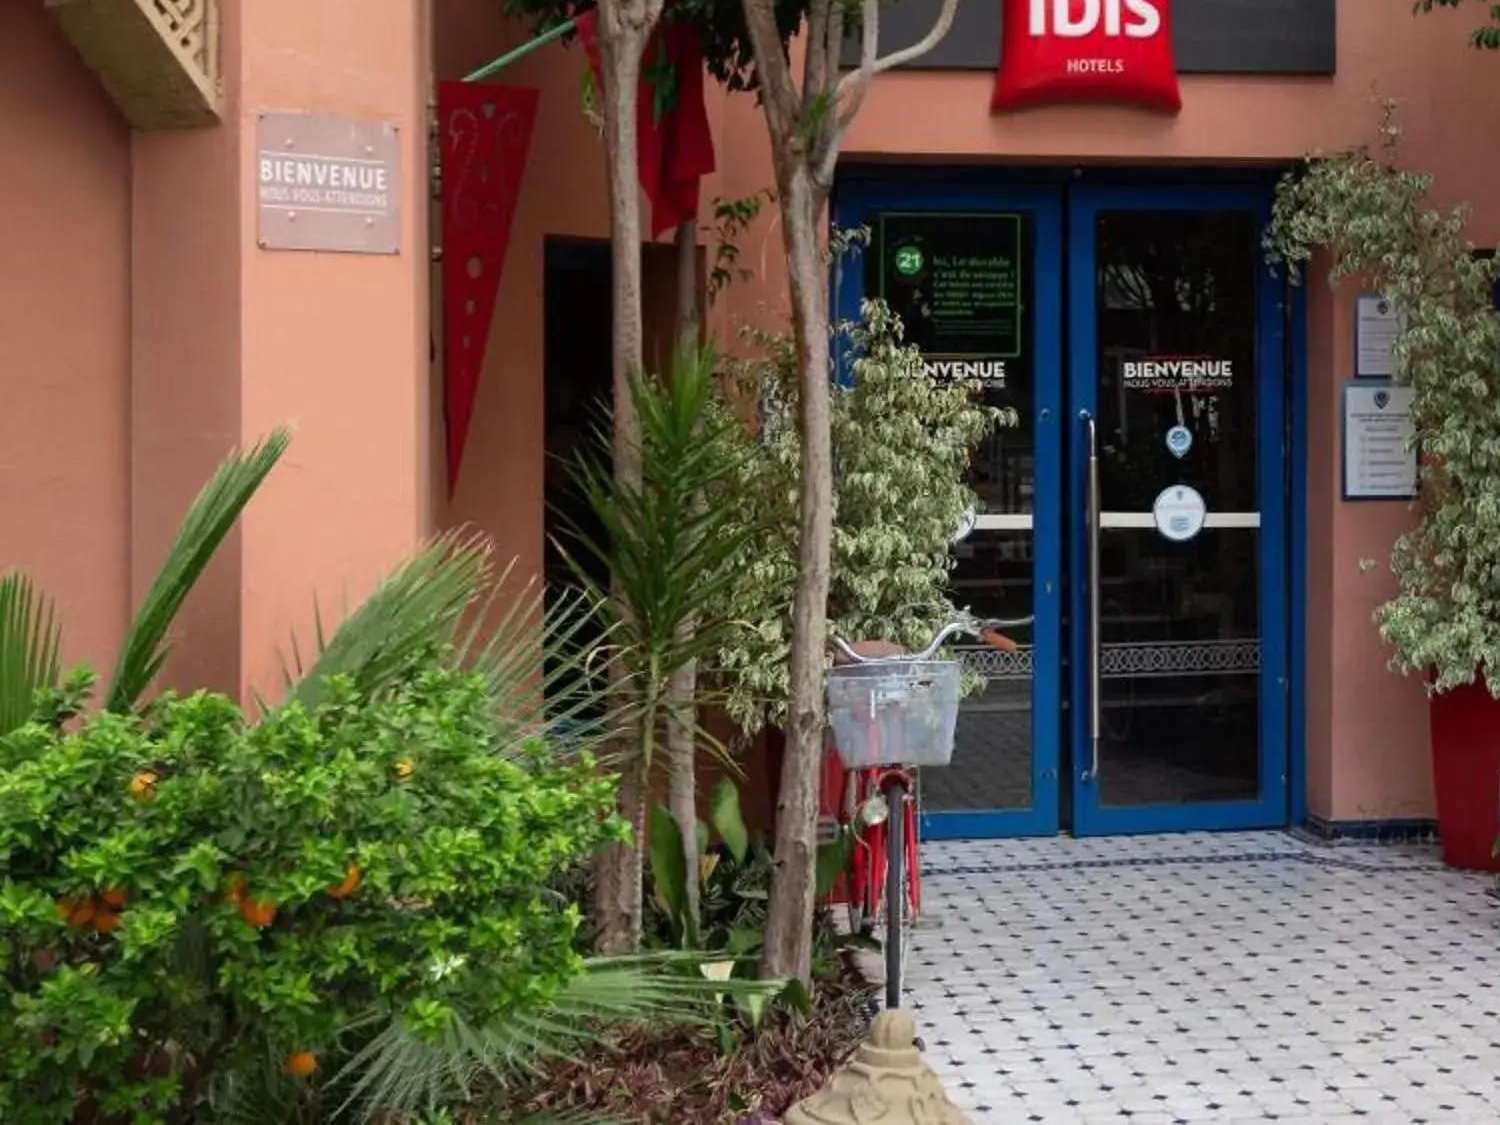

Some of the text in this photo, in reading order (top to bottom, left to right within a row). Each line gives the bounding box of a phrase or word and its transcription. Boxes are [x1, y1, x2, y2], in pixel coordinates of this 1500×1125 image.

[1067, 59, 1124, 73] HOTELS
[260, 159, 387, 190] BIENVENUE
[1123, 360, 1233, 378] BIENVENUE
